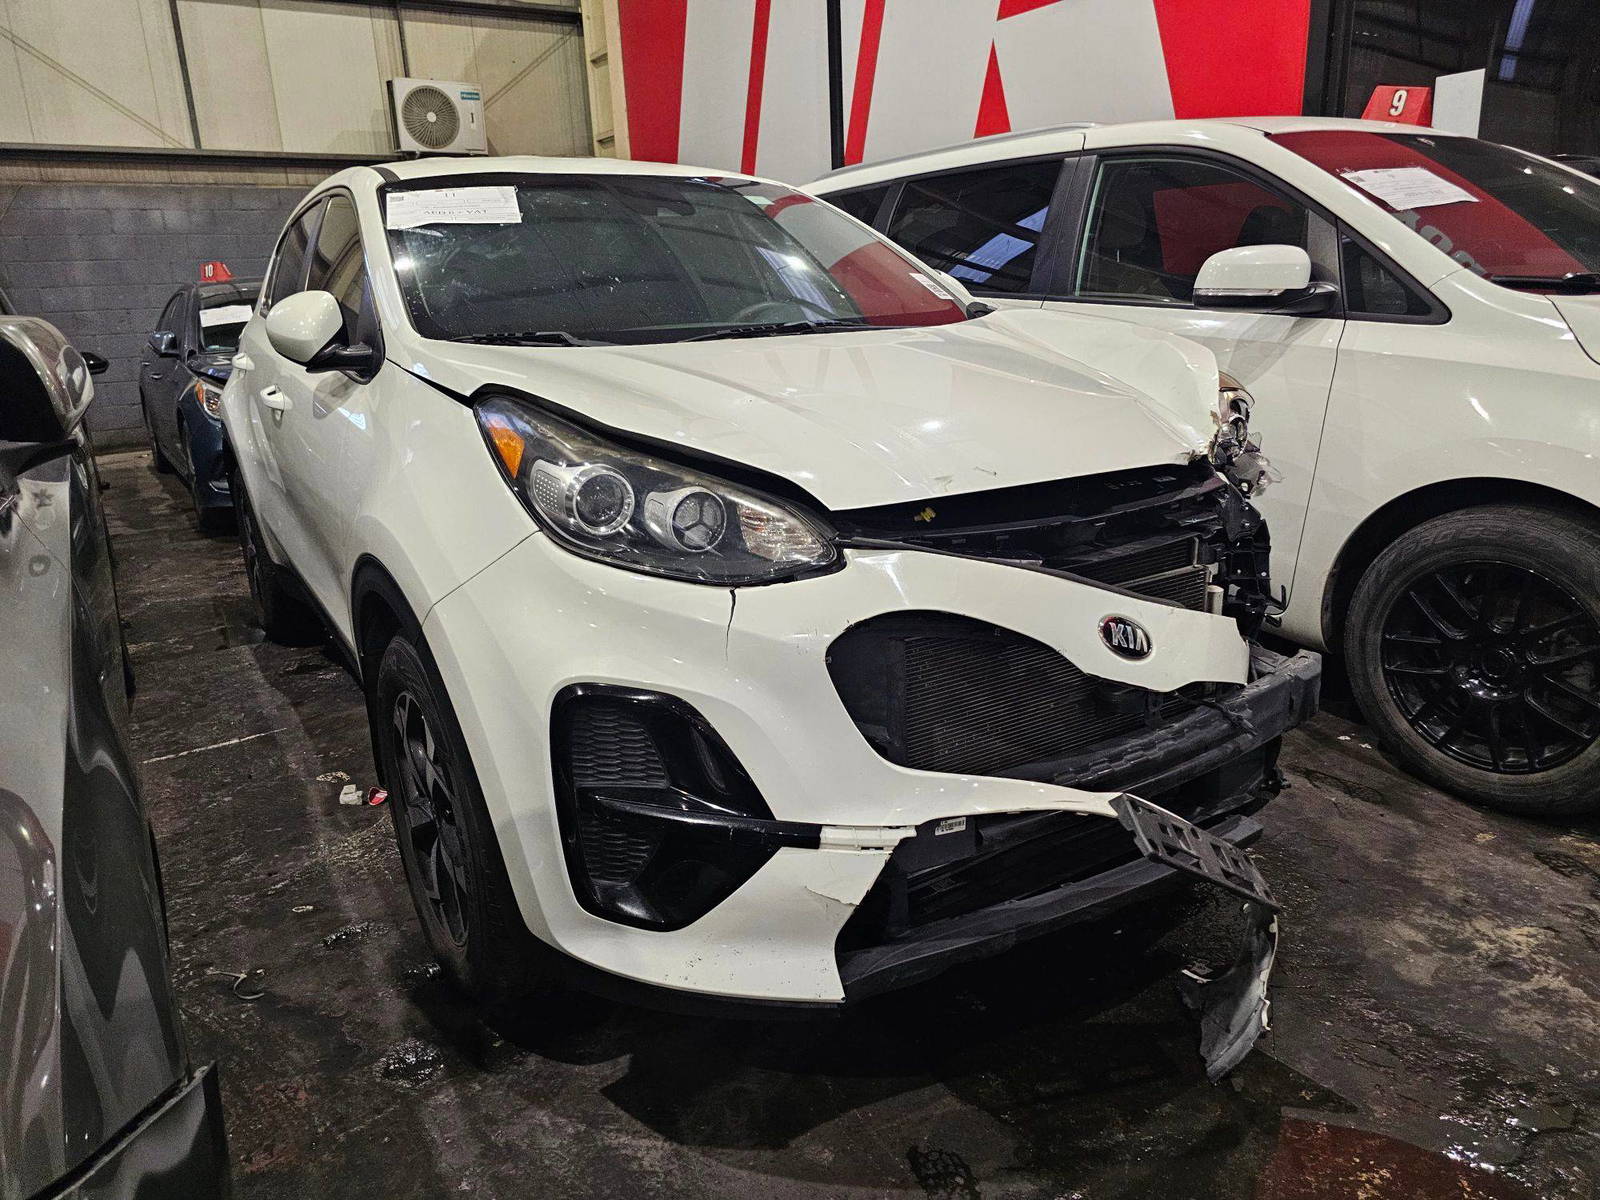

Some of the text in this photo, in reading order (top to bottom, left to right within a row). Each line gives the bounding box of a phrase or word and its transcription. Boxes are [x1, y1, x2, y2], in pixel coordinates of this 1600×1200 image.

[1389, 90, 1407, 115] 9
[206, 264, 214, 277] 10
[1109, 622, 1148, 652] KIA
